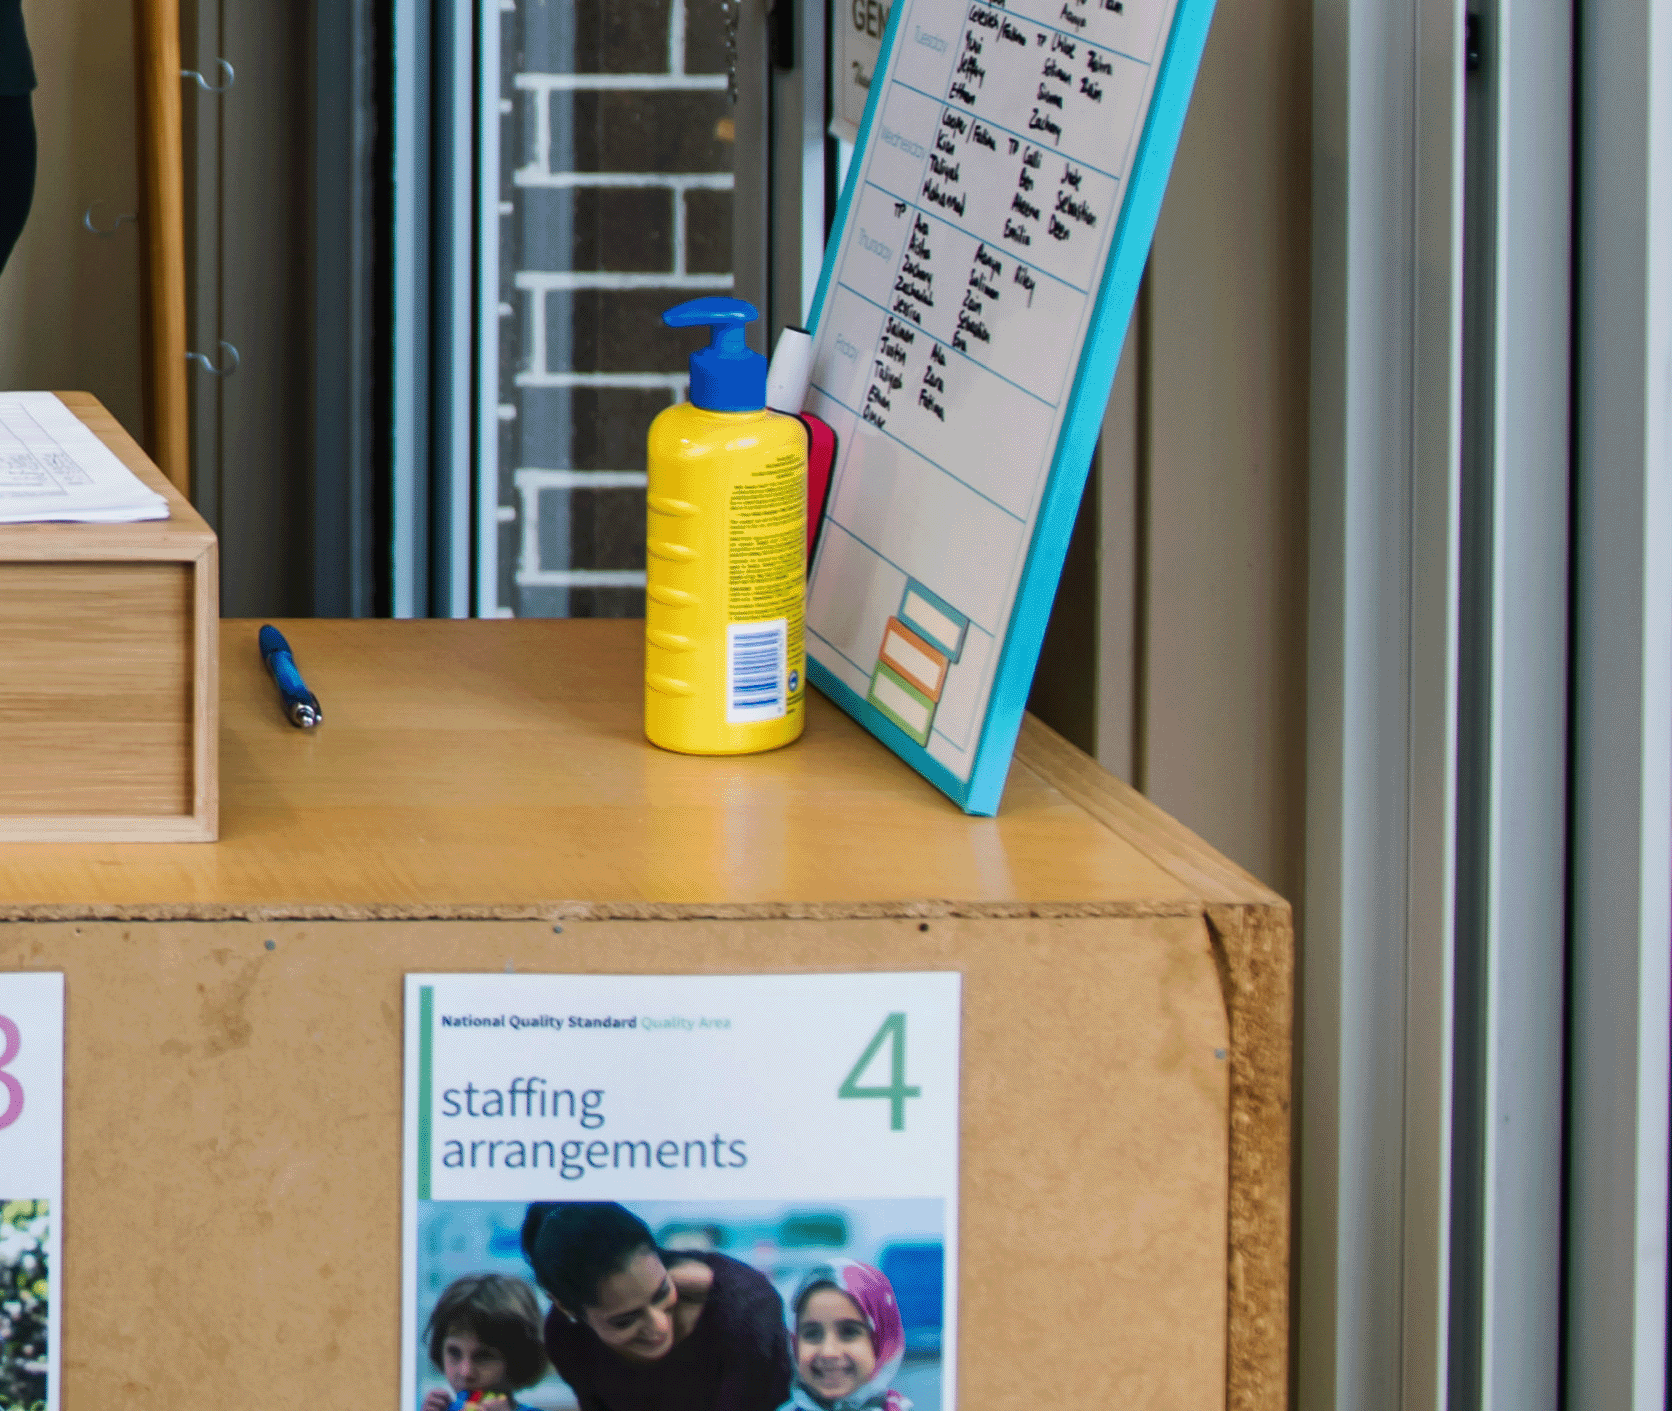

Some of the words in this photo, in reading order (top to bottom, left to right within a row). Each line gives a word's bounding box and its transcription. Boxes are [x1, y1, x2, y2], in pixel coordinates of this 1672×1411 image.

[442, 1016, 506, 1029] National
[510, 1016, 564, 1031] Quality
[569, 1017, 638, 1030] Standard
[640, 1017, 695, 1031] Quality
[698, 1017, 733, 1031] Area
[838, 1013, 923, 1133] 4
[443, 1077, 606, 1131] staffing
[443, 1135, 748, 1182] arrangements
